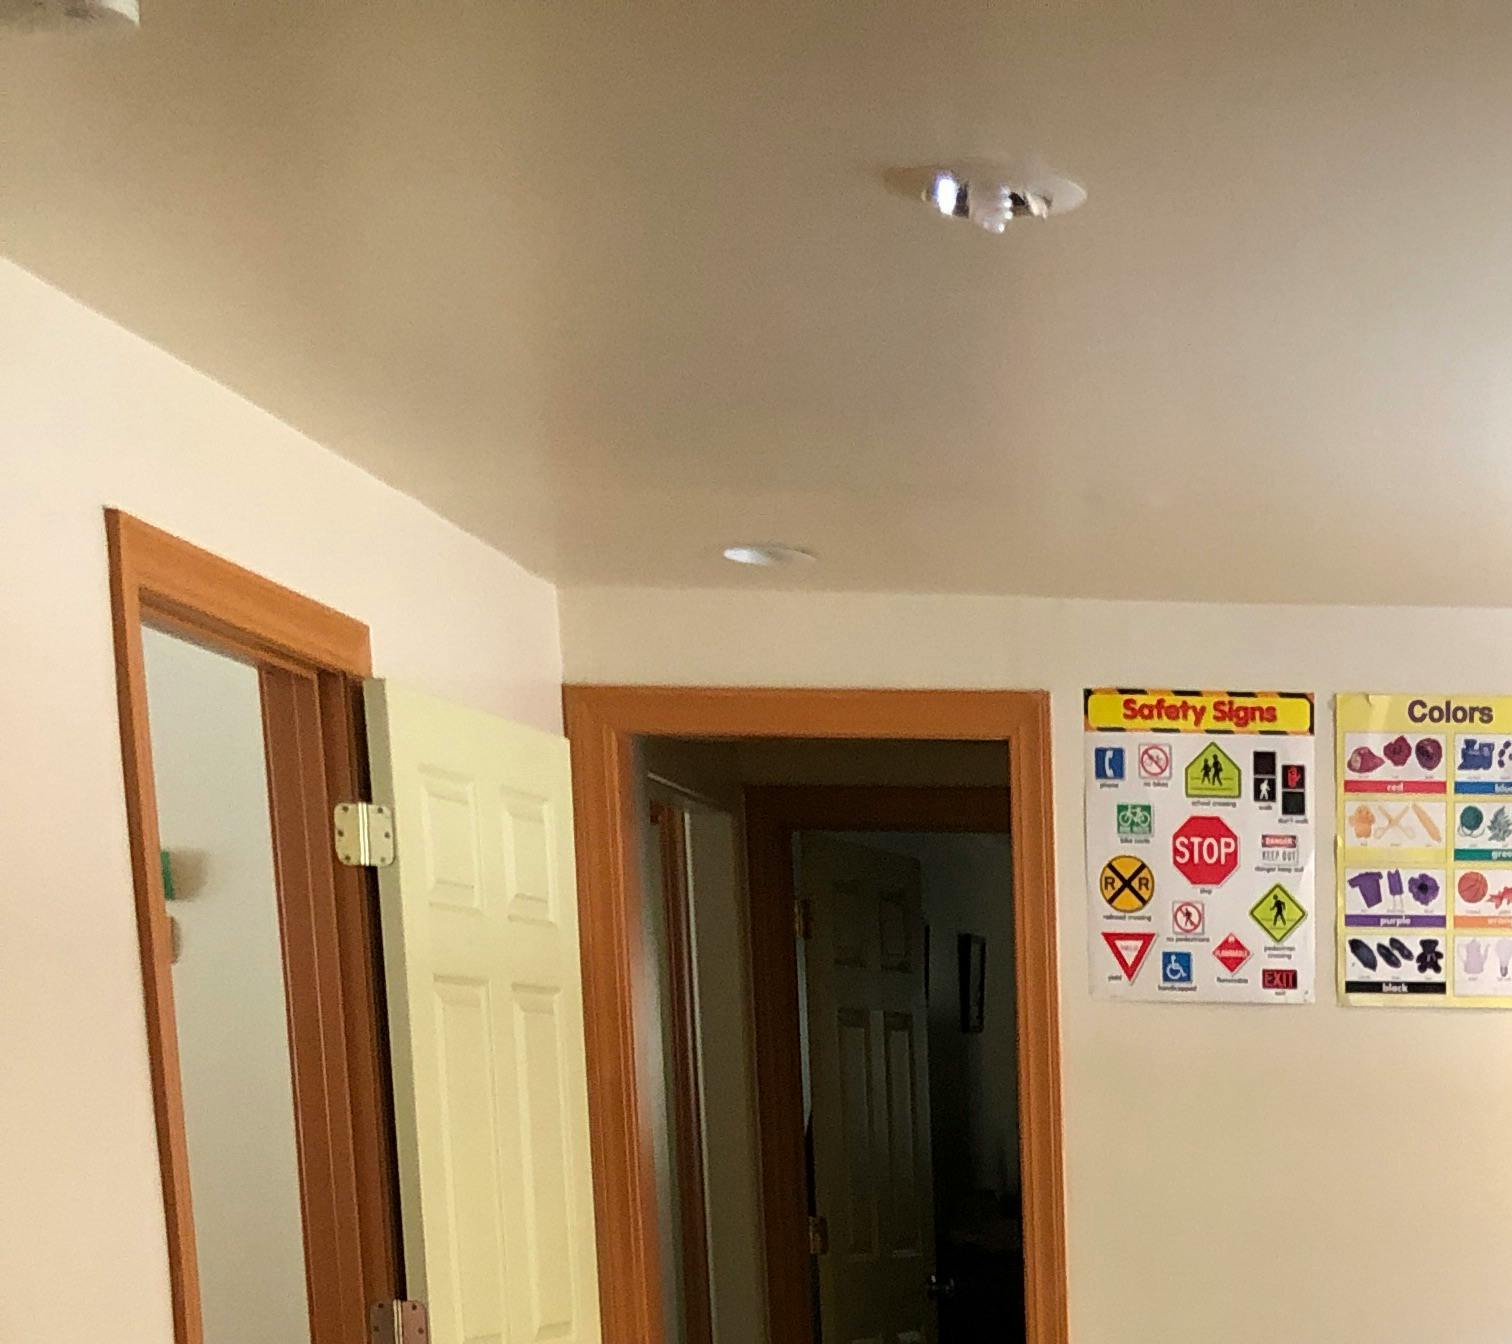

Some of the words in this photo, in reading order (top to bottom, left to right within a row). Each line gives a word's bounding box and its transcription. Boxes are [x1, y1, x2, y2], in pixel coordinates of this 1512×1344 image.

[1123, 698, 1206, 726] Safety
[1212, 700, 1278, 727] Signs
[1407, 699, 1494, 724] Colors
[1386, 782, 1404, 792] red
[1175, 836, 1235, 865] STOP
[1262, 850, 1279, 861] KEEP
[1282, 850, 1297, 861] OUT
[1104, 876, 1116, 891] R
[1138, 876, 1150, 891] R
[1380, 916, 1411, 927] purple
[1265, 971, 1295, 988] EXIT
[1382, 983, 1408, 993] black
